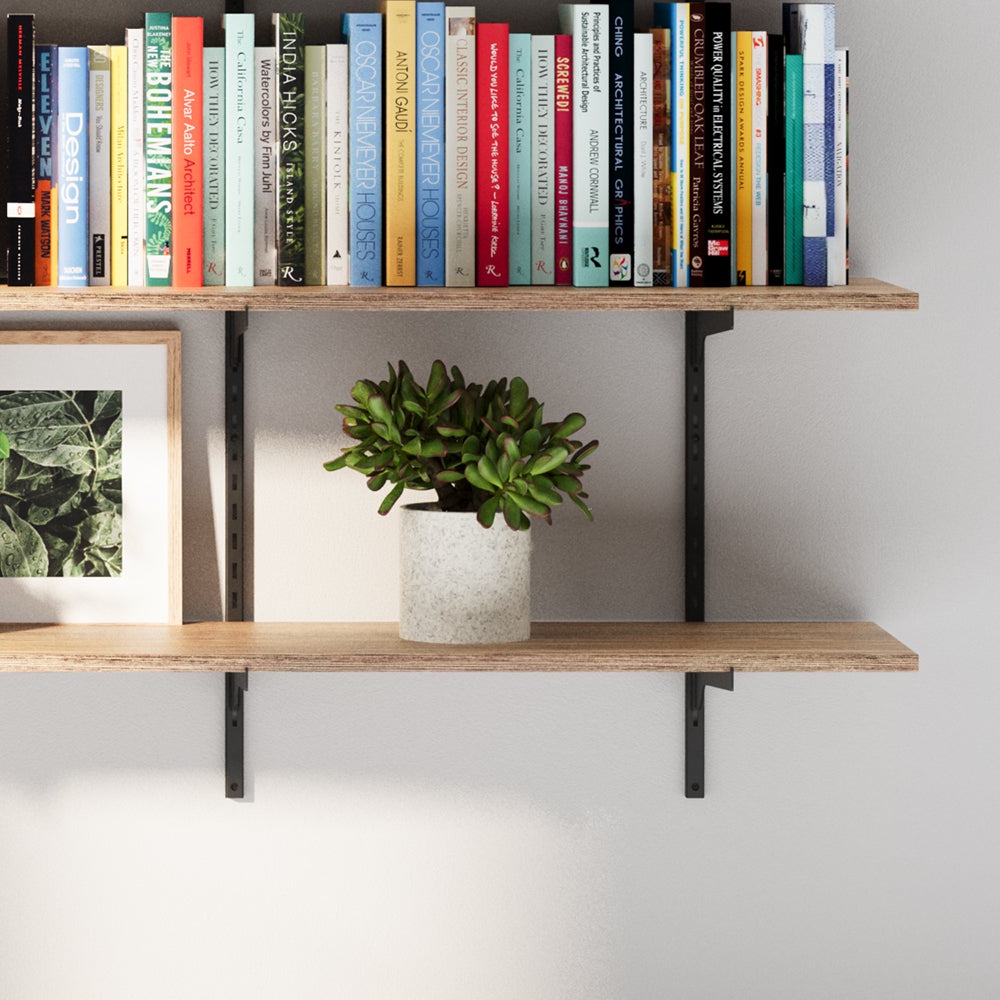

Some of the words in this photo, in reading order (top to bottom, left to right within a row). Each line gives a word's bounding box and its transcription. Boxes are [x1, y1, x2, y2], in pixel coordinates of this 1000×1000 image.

[283, 32, 296, 83] INDIA
[456, 38, 467, 85] CLASSIC
[184, 89, 195, 120] Alvar
[261, 59, 271, 127] Watercolors
[260, 131, 272, 143] by
[283, 92, 296, 151] HICKS
[457, 89, 467, 142] INTERIOR
[147, 72, 171, 214] BOHEMIANS
[183, 123, 195, 155] Aalto
[262, 146, 272, 169] Finn
[590, 130, 598, 165] ANDREW
[62, 112, 83, 224] Design
[184, 159, 195, 215] Architect
[262, 171, 272, 193] Juhl
[457, 147, 467, 189] DESIGN
[41, 191, 50, 217] MARK
[590, 168, 599, 213] CORNWALL
[40, 220, 50, 258] WATSON
